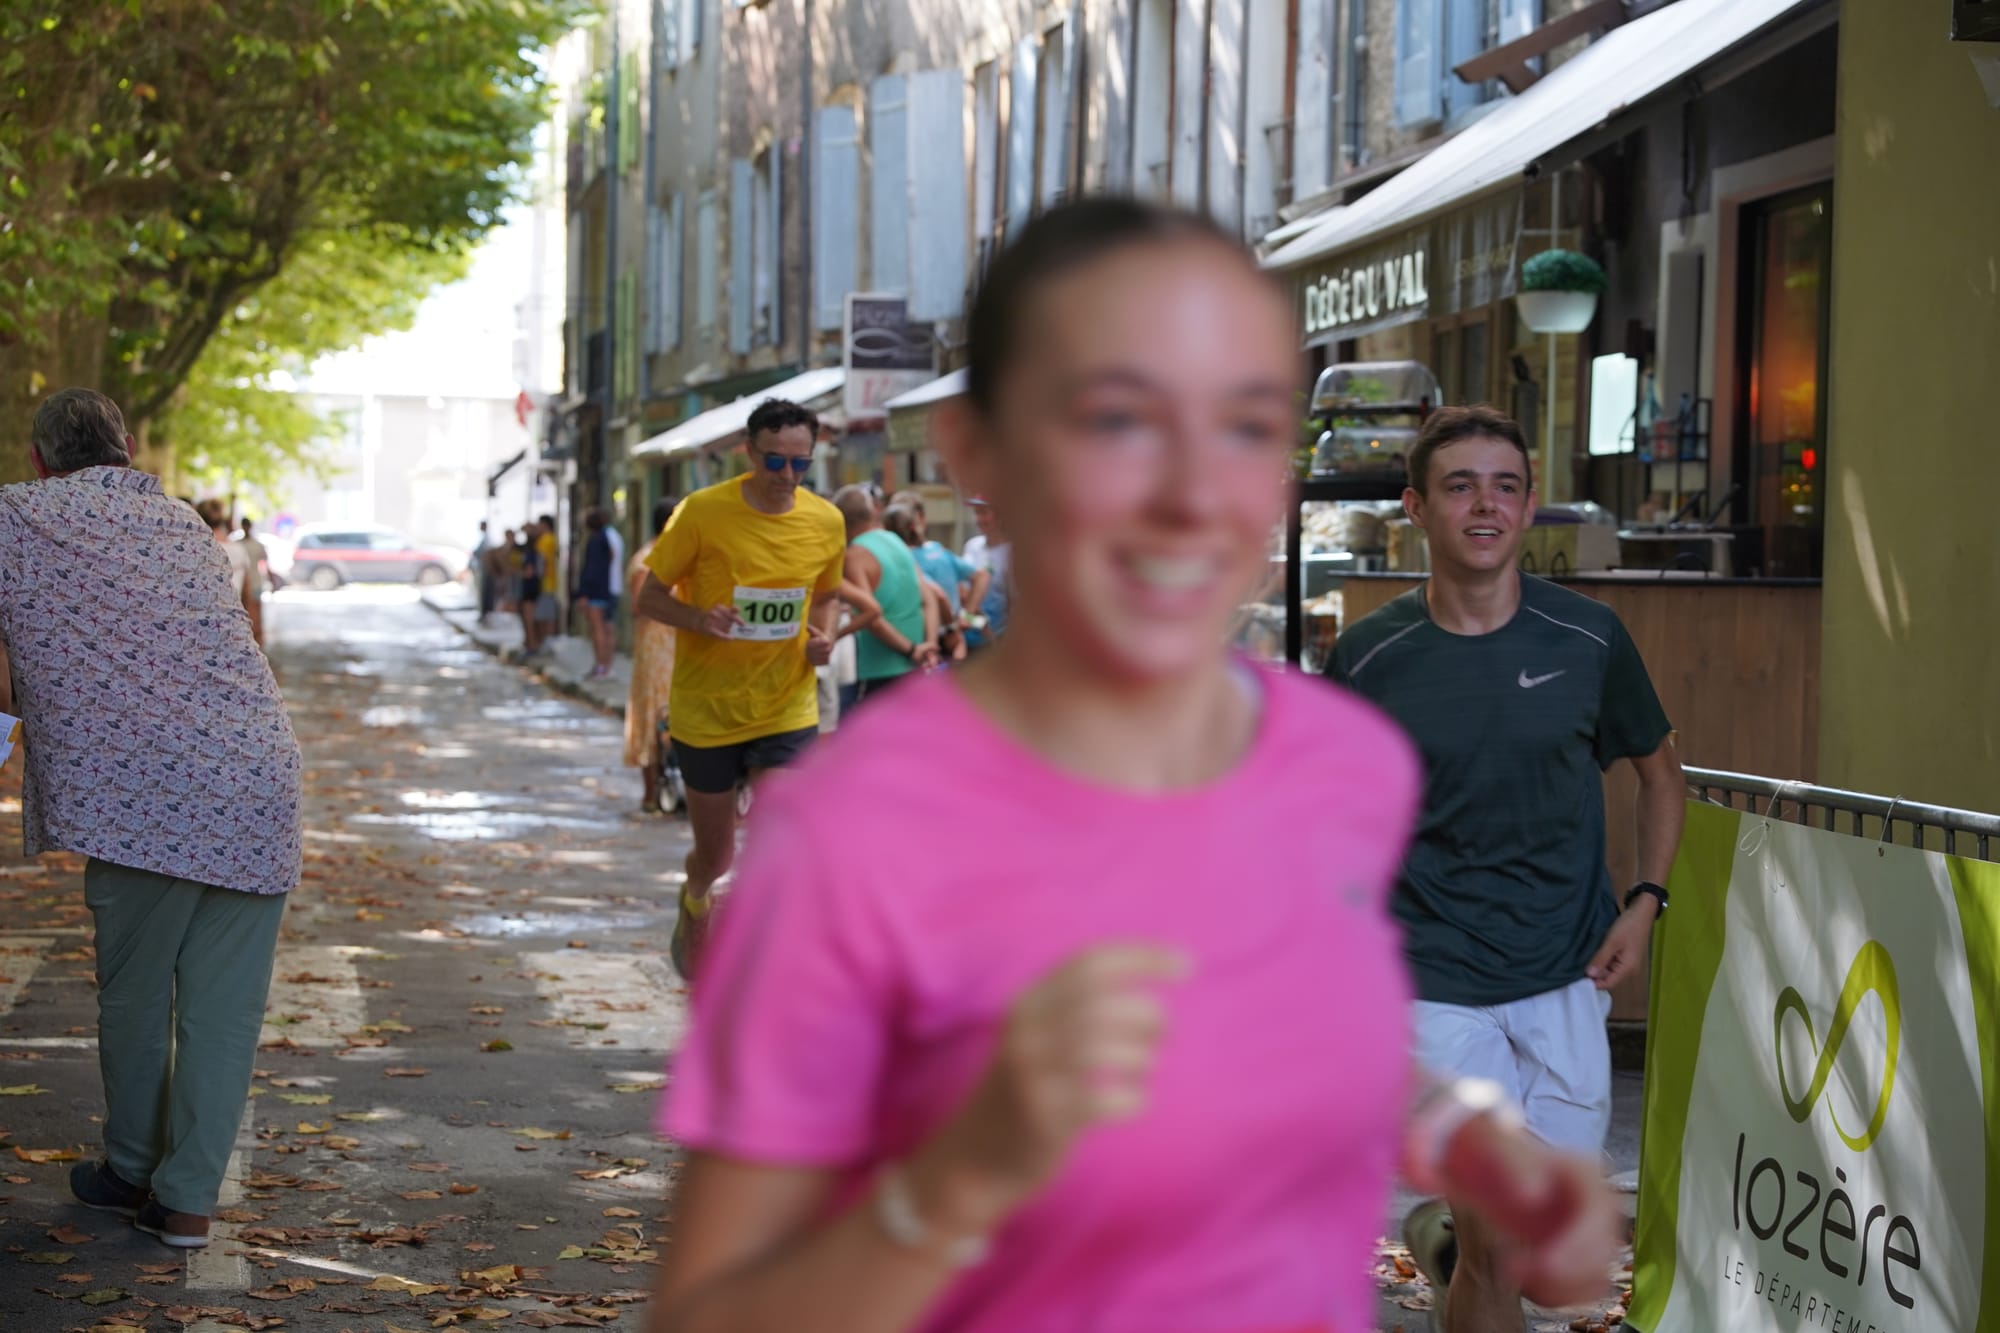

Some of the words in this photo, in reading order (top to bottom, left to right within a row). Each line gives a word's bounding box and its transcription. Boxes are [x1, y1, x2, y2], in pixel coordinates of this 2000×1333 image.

[1306, 268, 1350, 333] DÉDÉ
[1351, 265, 1381, 320] DU
[1383, 250, 1428, 310] VAL
[743, 602, 795, 624] 100
[1733, 1132, 1921, 1309] lozère
[1724, 1255, 1744, 1286] LE
[1754, 1272, 1886, 1333] DÉPARTEM
